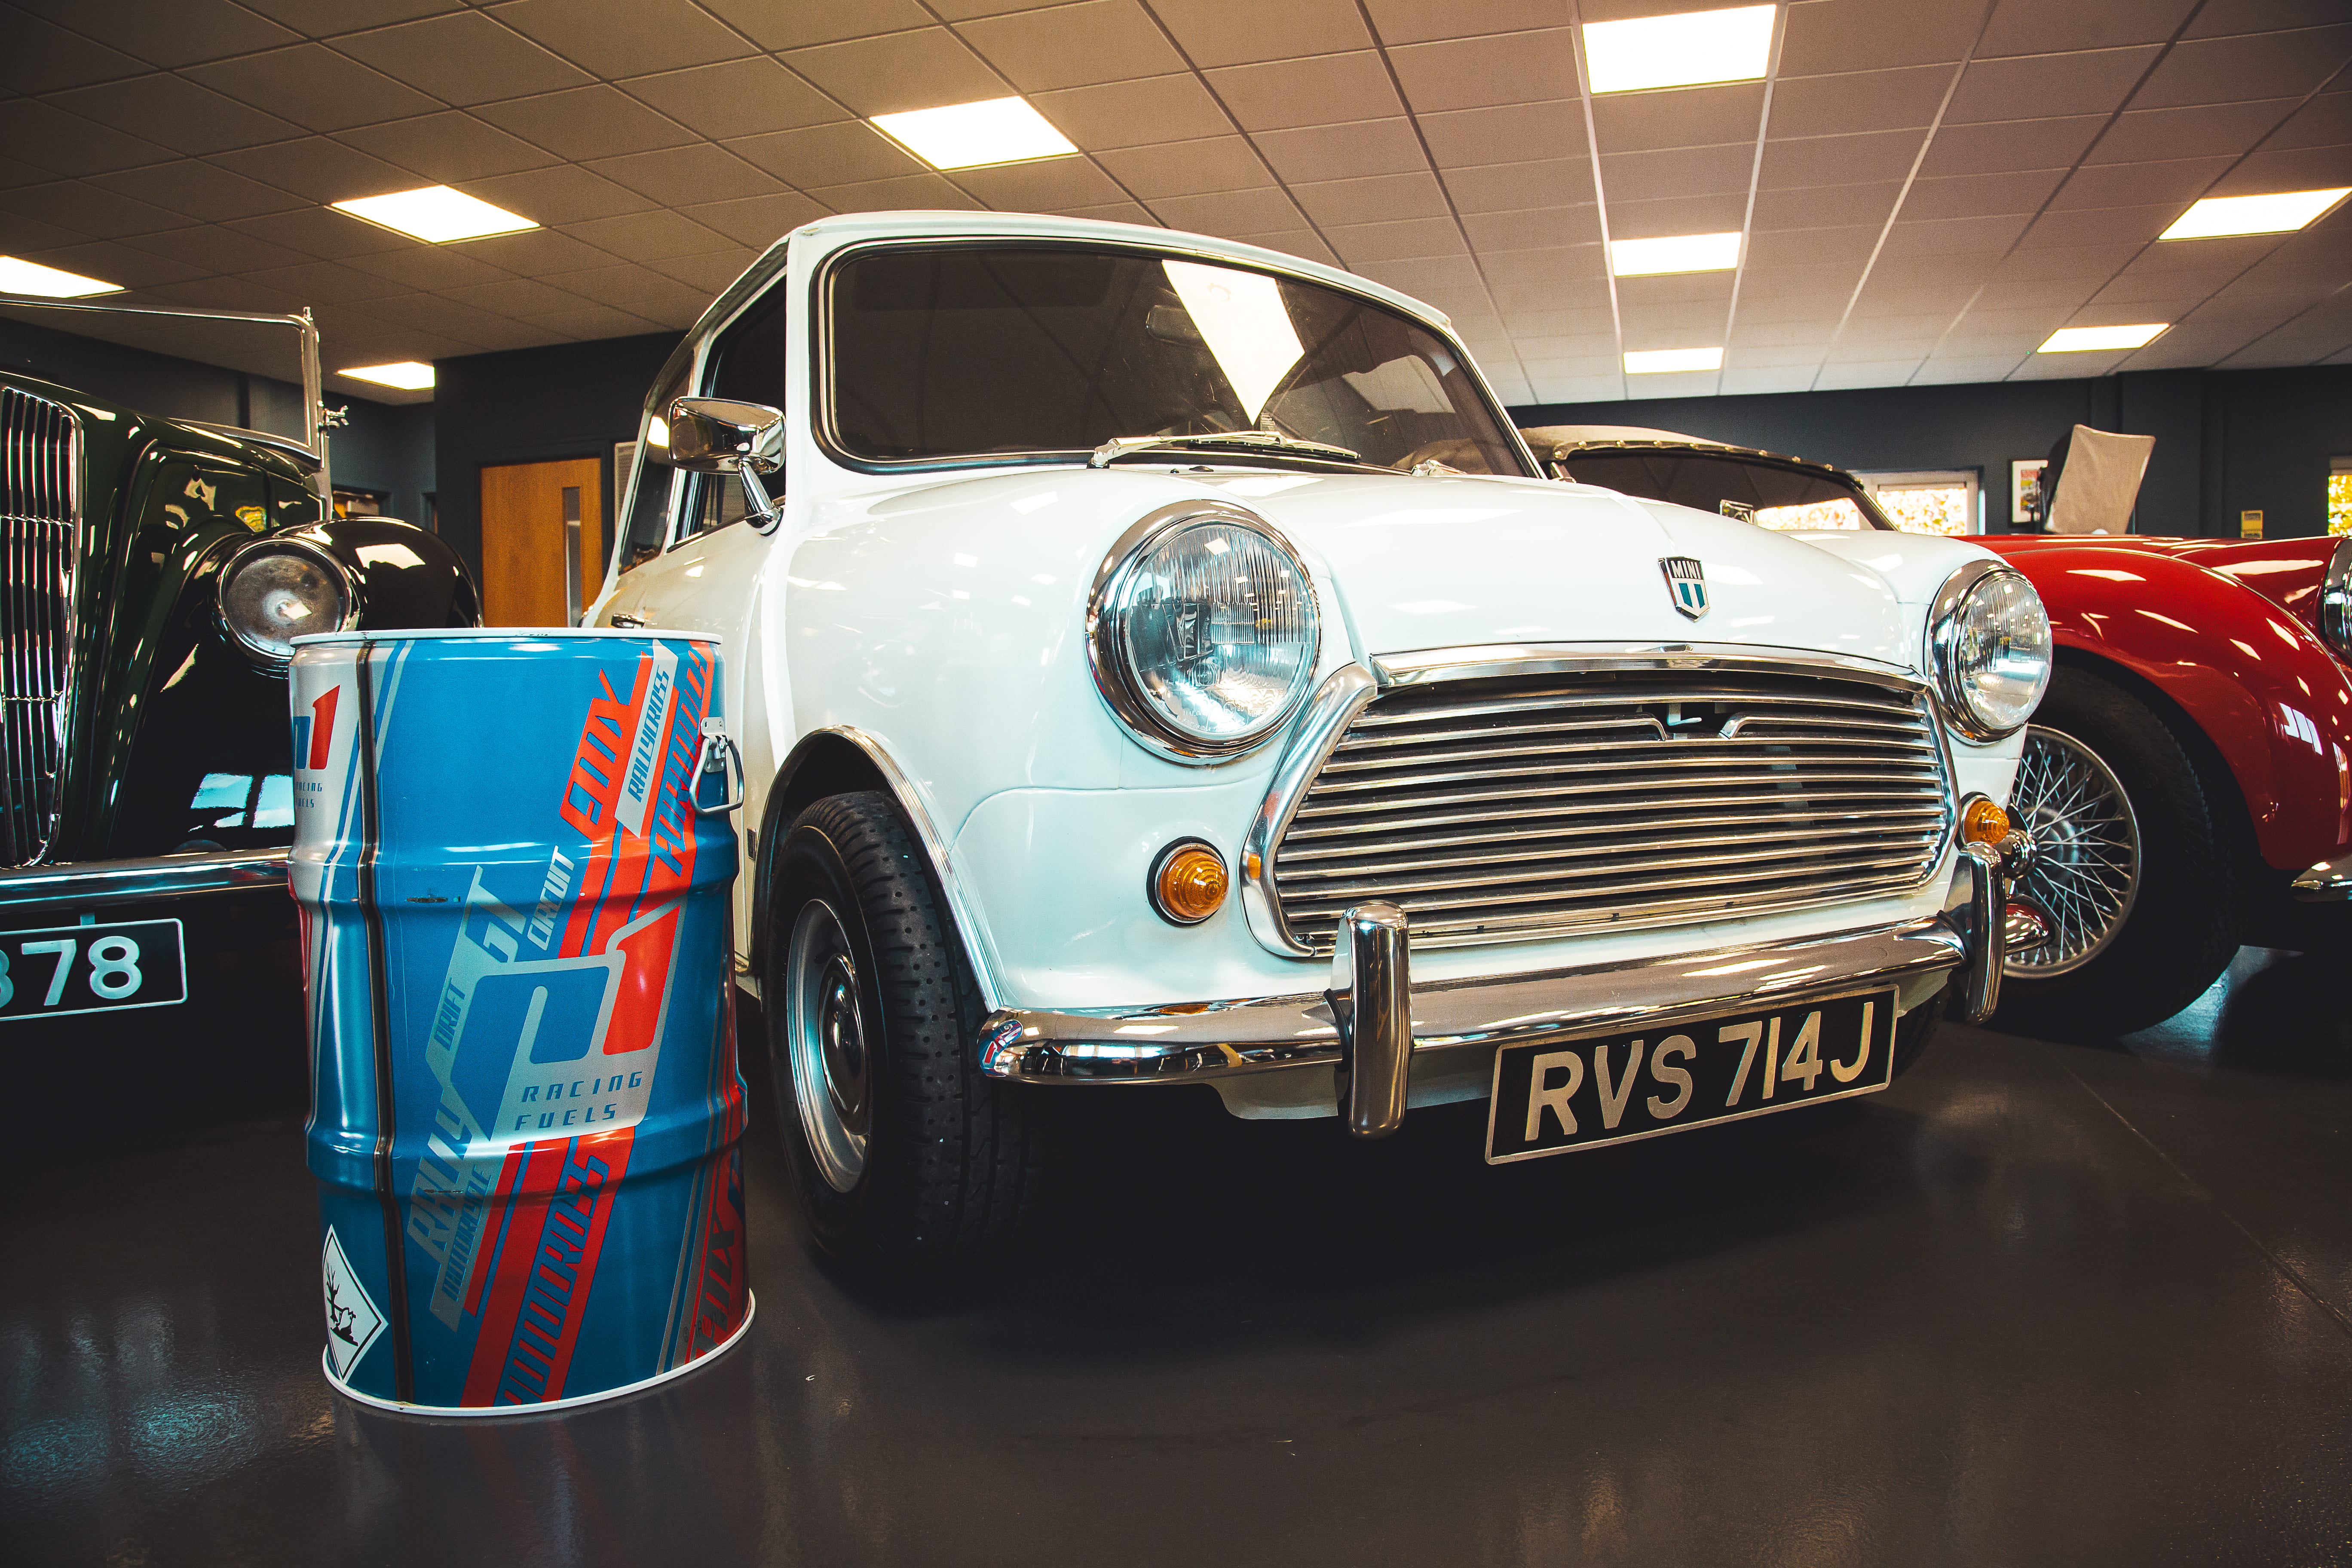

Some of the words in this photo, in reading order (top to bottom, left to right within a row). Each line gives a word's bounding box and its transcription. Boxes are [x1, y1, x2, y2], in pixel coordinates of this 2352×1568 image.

[1670, 560, 1701, 579] MINI
[628, 665, 670, 802] RALLYCROSS
[456, 864, 527, 967] GT
[527, 845, 575, 951] CIRCUIT
[433, 977, 466, 1052] DRIFT
[514, 1103, 617, 1131] FUELS
[521, 1071, 643, 1102] RACING
[1525, 1035, 1696, 1142] RVS
[1718, 1001, 1873, 1106] 714J
[407, 1085, 474, 1265] RALLY
[442, 1164, 492, 1302] MOTORCYCLE
